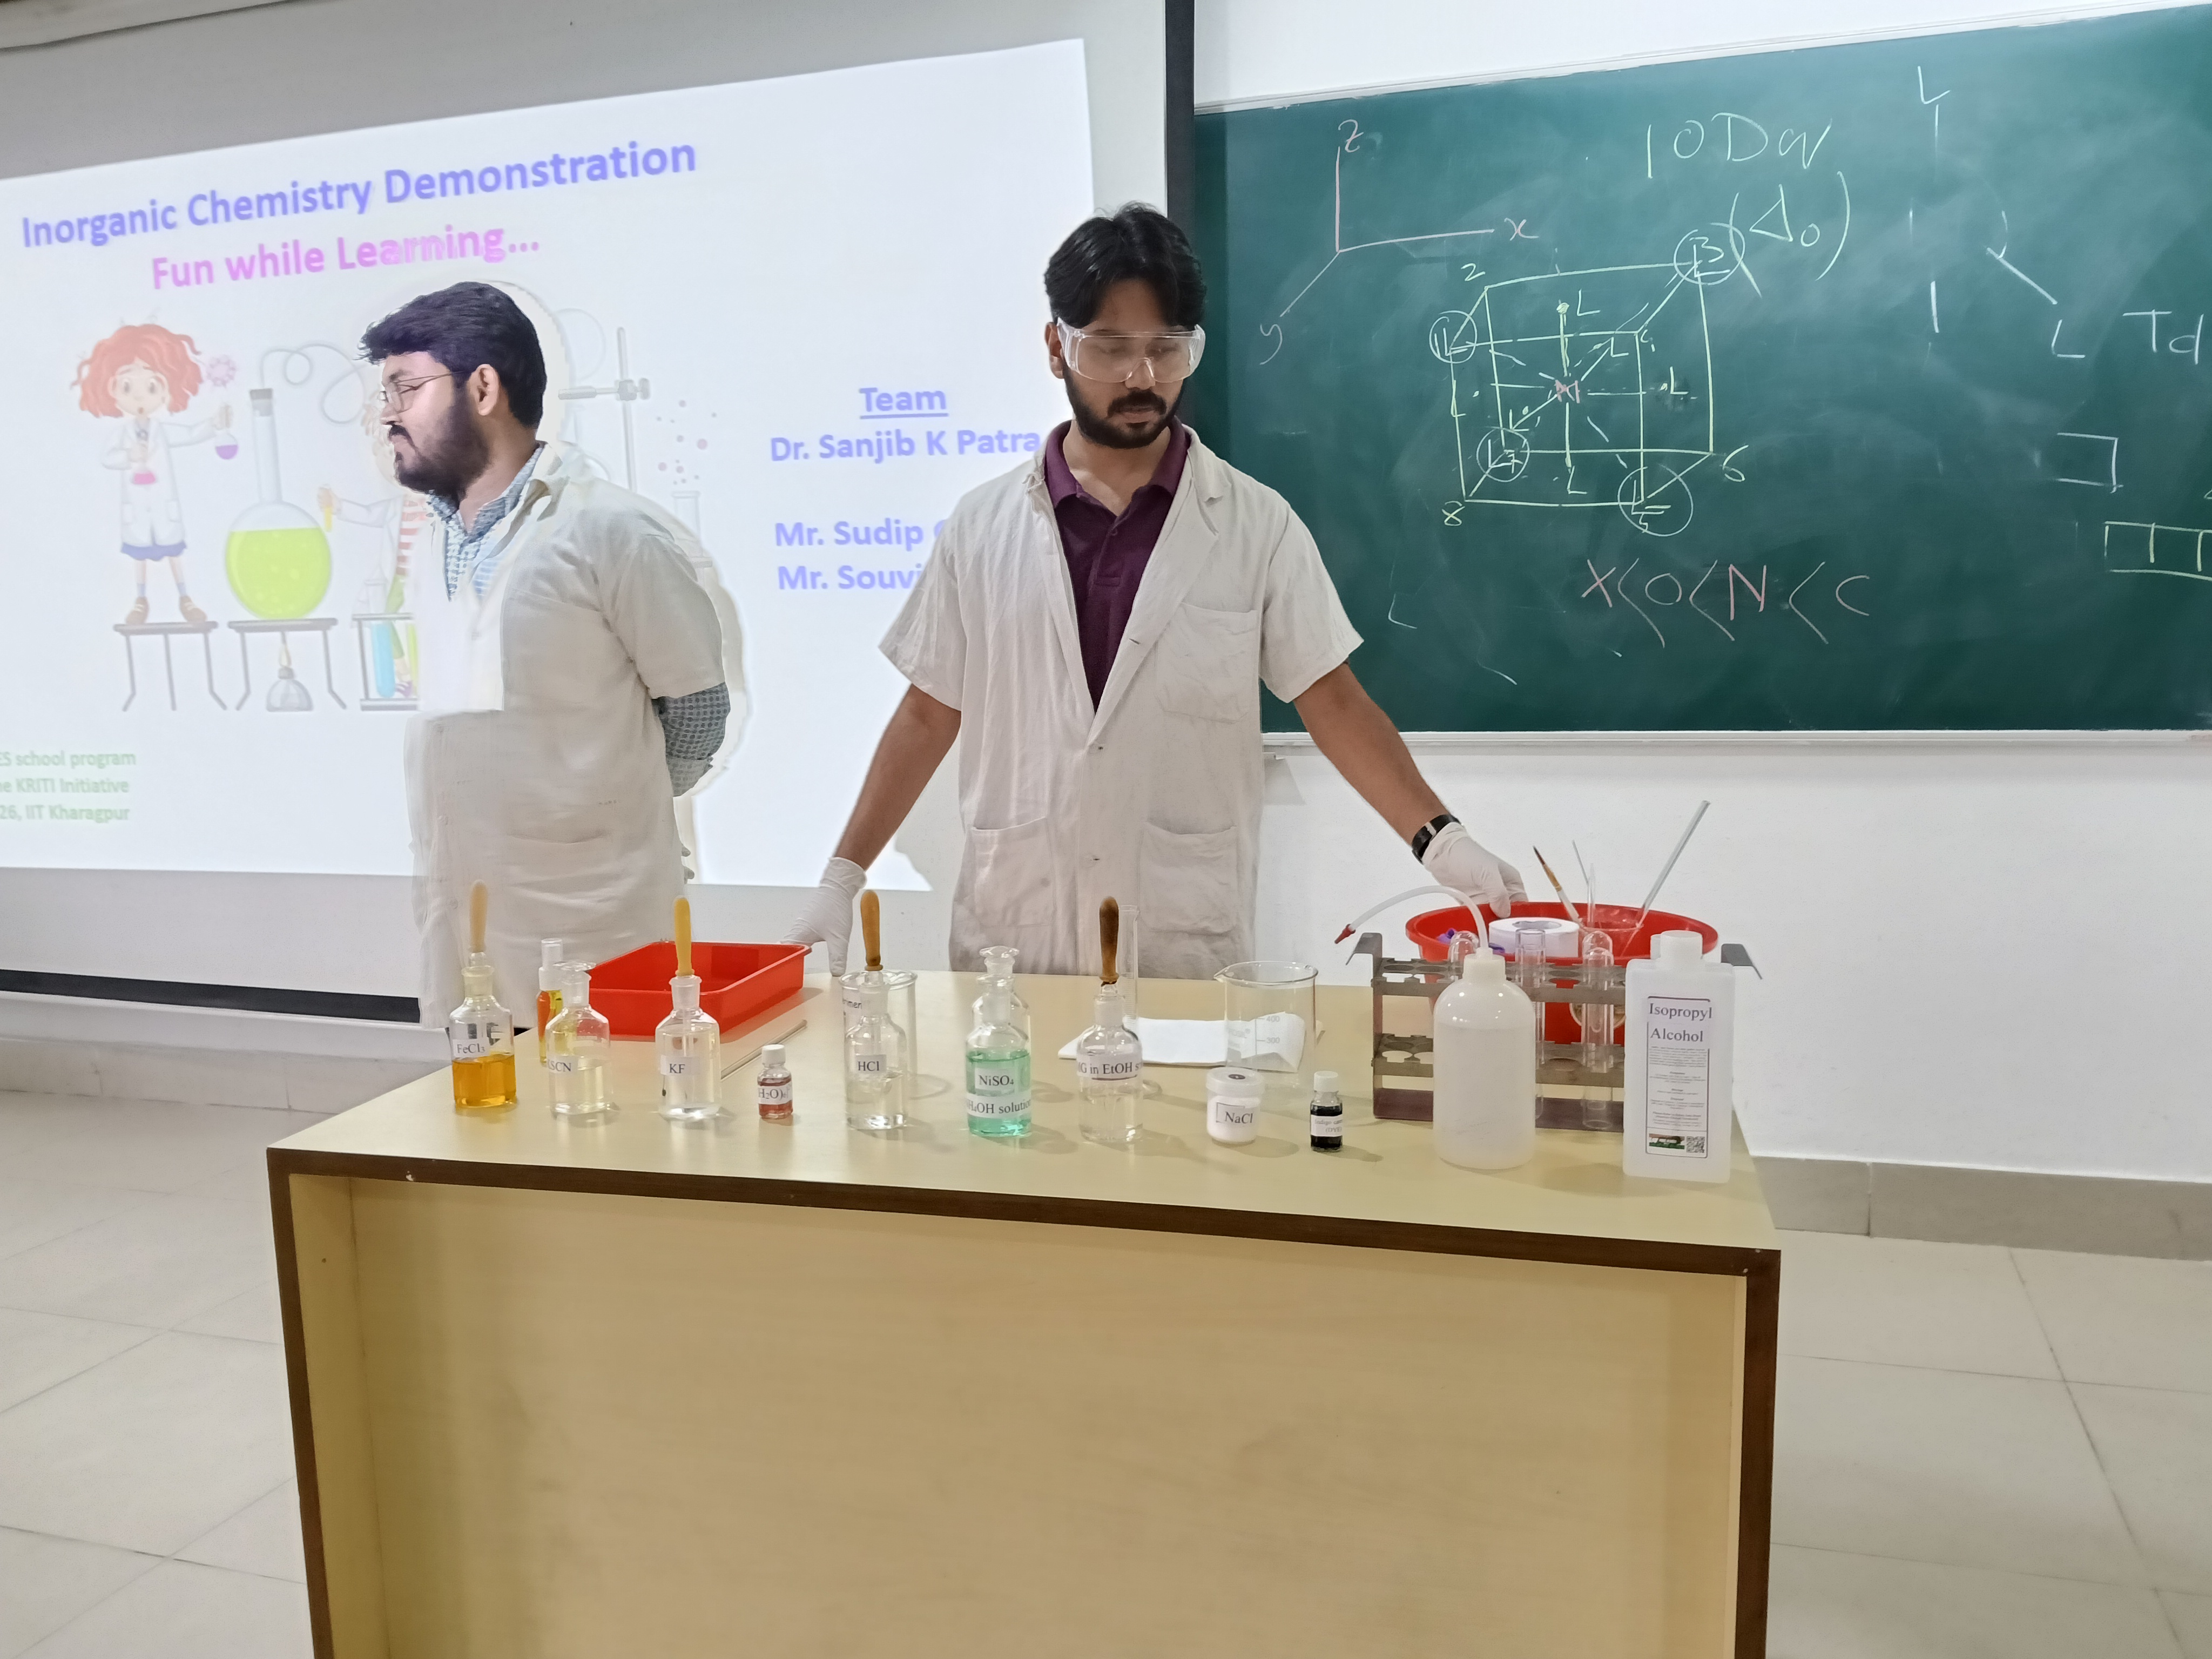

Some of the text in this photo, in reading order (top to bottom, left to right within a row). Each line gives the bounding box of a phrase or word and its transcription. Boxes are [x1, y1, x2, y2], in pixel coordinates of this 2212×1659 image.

[23, 140, 697, 248] Inorganic Chemistry Demonstration
[152, 224, 539, 290] Fun while Learning...
[859, 387, 947, 413] Team
[770, 428, 1042, 464] Dr. Sanjib K Patra
[775, 522, 824, 547] Mr.
[833, 517, 925, 551] Sudip
[778, 565, 828, 590] Mr.
[15, 750, 66, 766] school
[70, 753, 137, 770] program
[59, 778, 130, 793] Initiative
[25, 804, 45, 820] IIT
[48, 804, 131, 824] Kharagpur
[1649, 1002, 1712, 1022] Isopropyl
[1266, 1036, 1280, 1044] 300
[1650, 1028, 1703, 1042] Alcohol
[669, 1063, 686, 1074] KF
[857, 1060, 880, 1072] HCl
[1089, 1063, 1099, 1075] in
[1102, 1061, 1133, 1075] EtOH
[1224, 1110, 1255, 1124] NaCl
